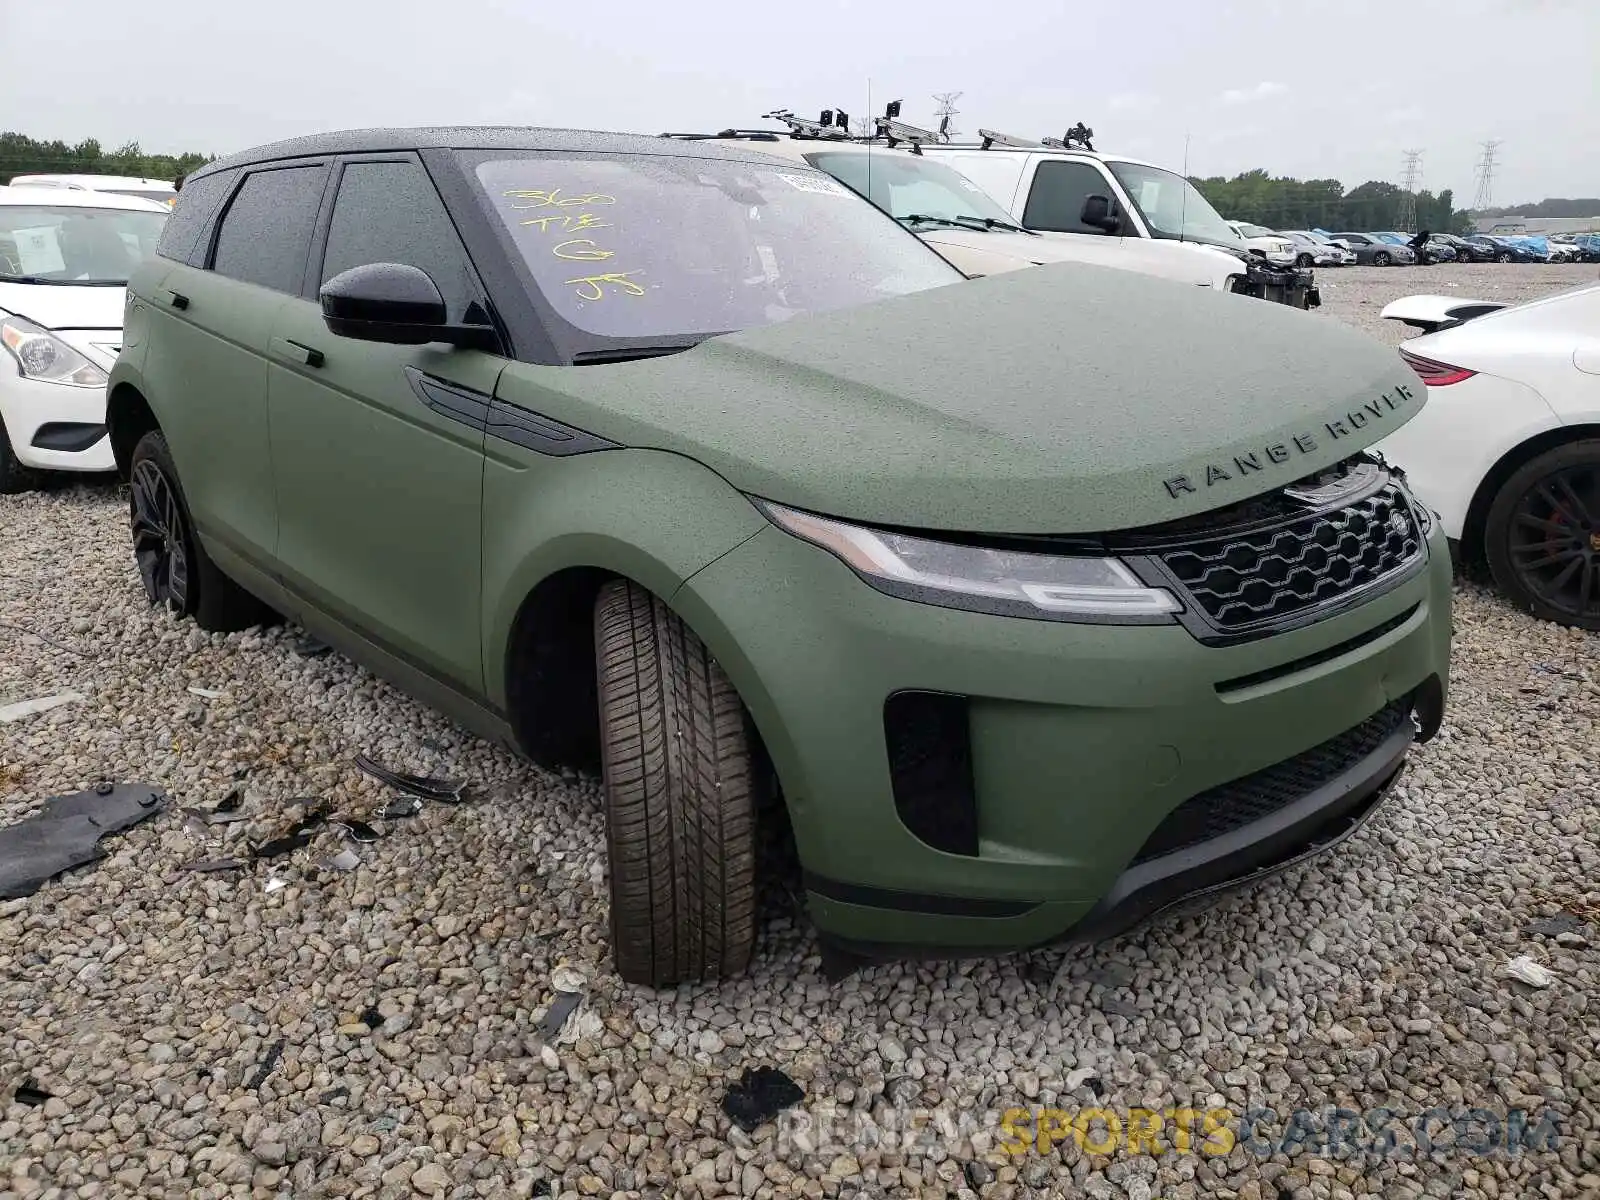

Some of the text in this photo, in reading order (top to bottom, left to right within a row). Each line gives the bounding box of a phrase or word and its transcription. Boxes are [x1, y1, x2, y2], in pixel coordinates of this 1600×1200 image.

[502, 189, 616, 209] 360
[1163, 384, 1413, 498] RANGE ROVER
